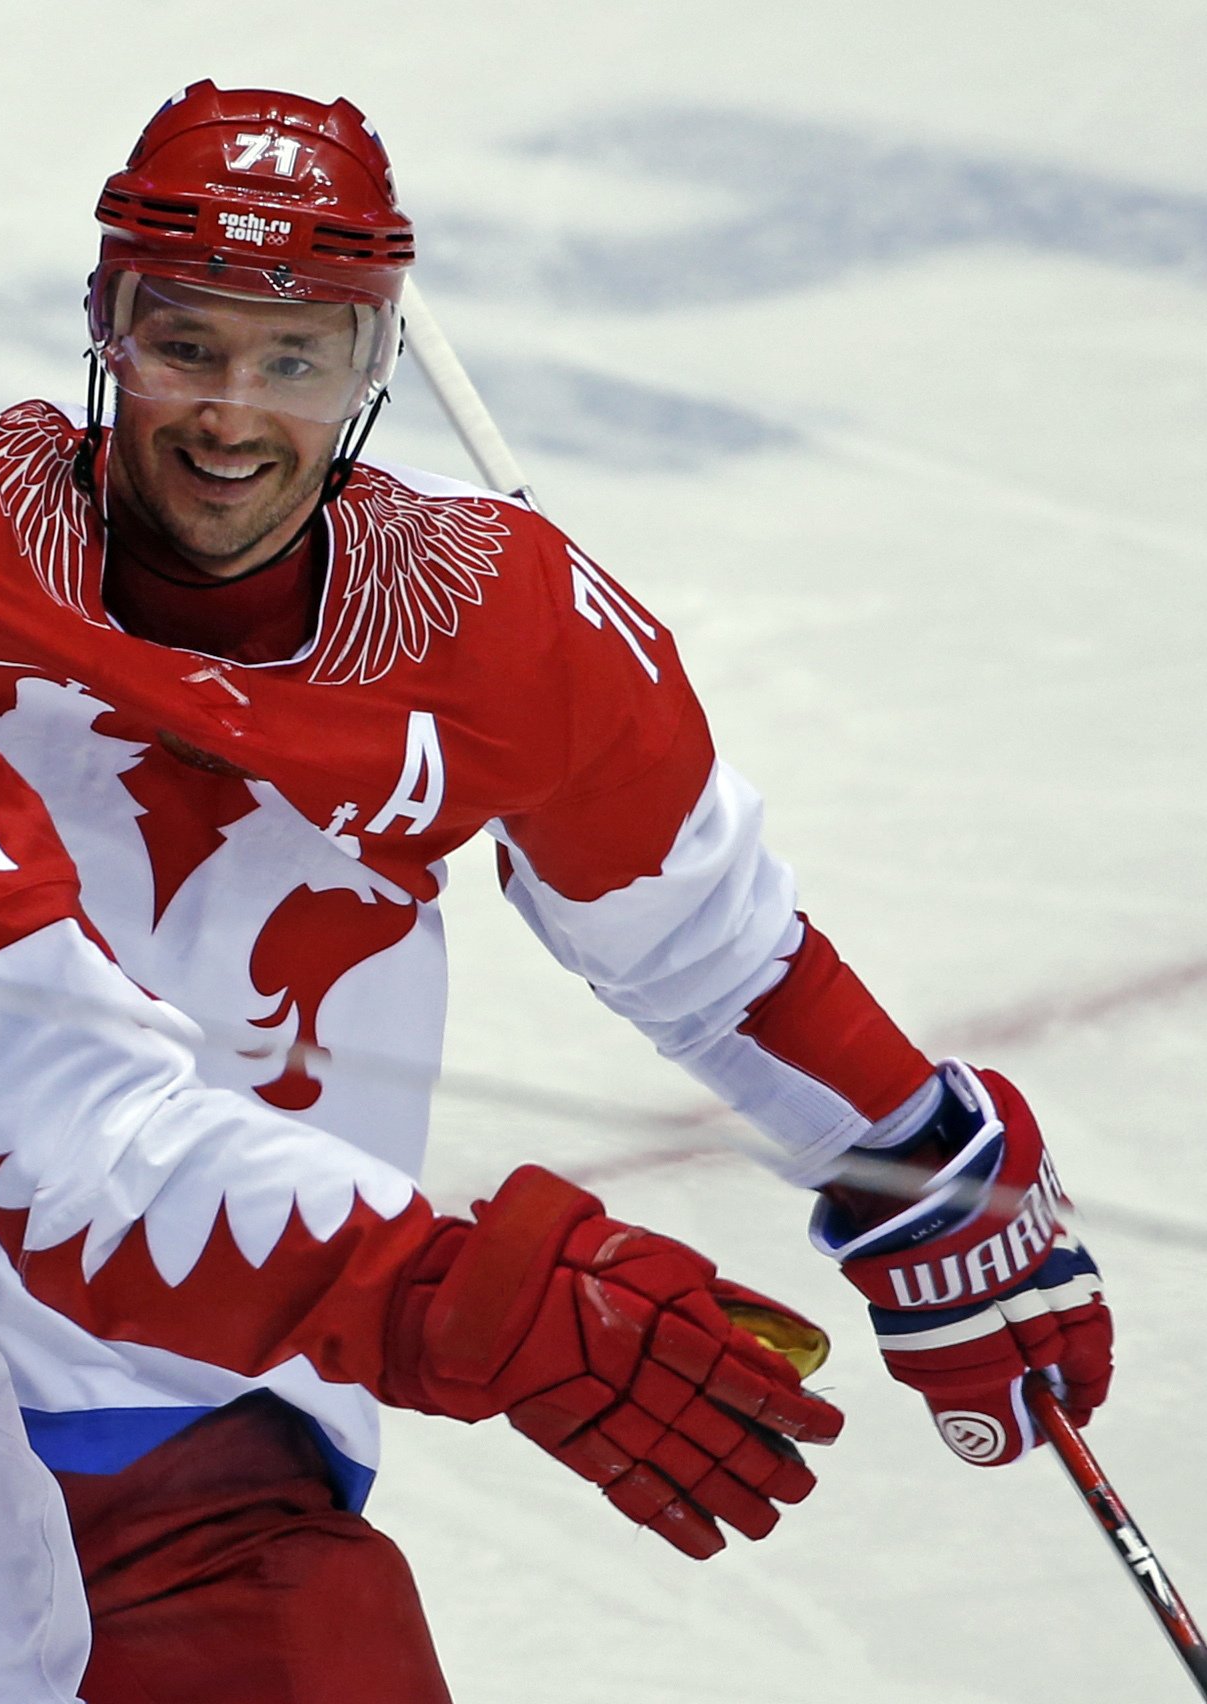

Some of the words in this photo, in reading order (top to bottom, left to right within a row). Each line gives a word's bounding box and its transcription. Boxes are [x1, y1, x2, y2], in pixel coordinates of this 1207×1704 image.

[230, 133, 301, 177] 71
[218, 211, 292, 235] sochi.ru
[225, 226, 264, 247] 2014
[565, 543, 659, 684] 71
[364, 710, 446, 836] A
